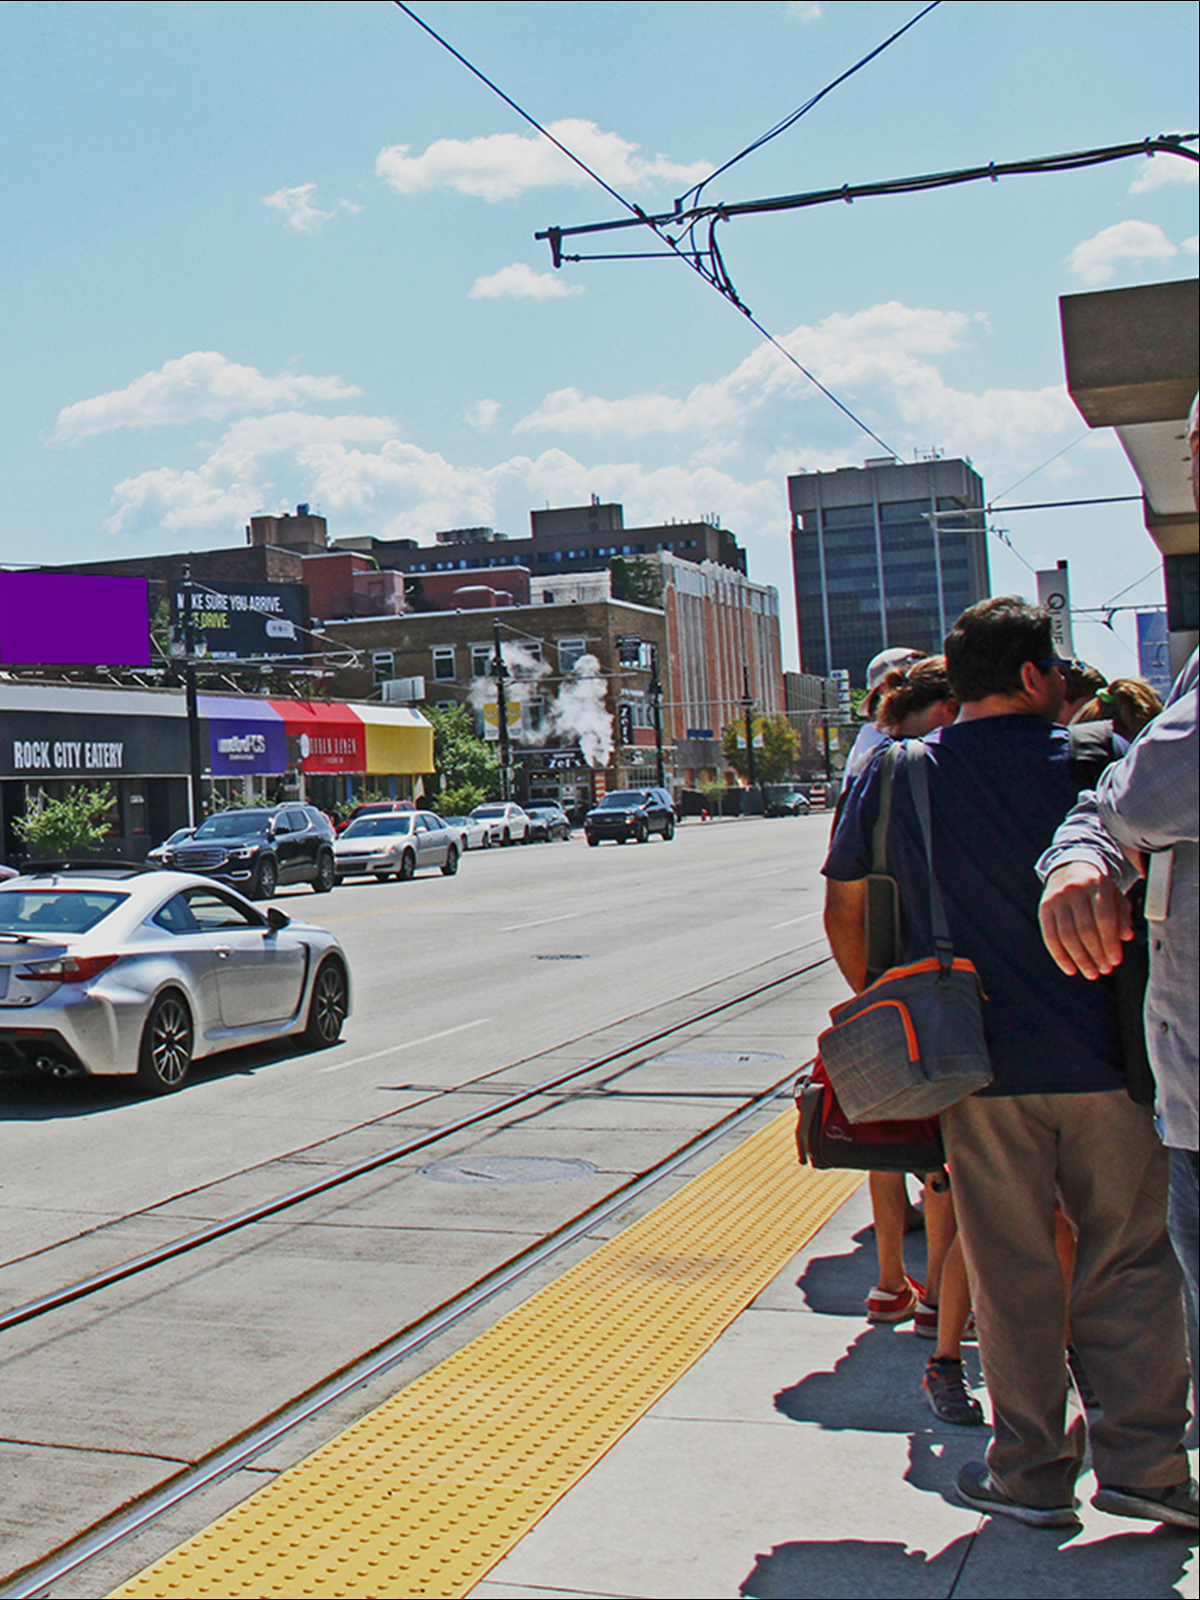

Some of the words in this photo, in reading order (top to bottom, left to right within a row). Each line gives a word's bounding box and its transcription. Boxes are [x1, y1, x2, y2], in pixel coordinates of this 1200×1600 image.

[205, 594, 228, 610] SURE
[230, 594, 247, 611] YOU
[249, 596, 284, 612] ARRIVE.
[13, 740, 51, 769] ROCK
[53, 741, 81, 769] CITY
[84, 742, 124, 768] EATERY
